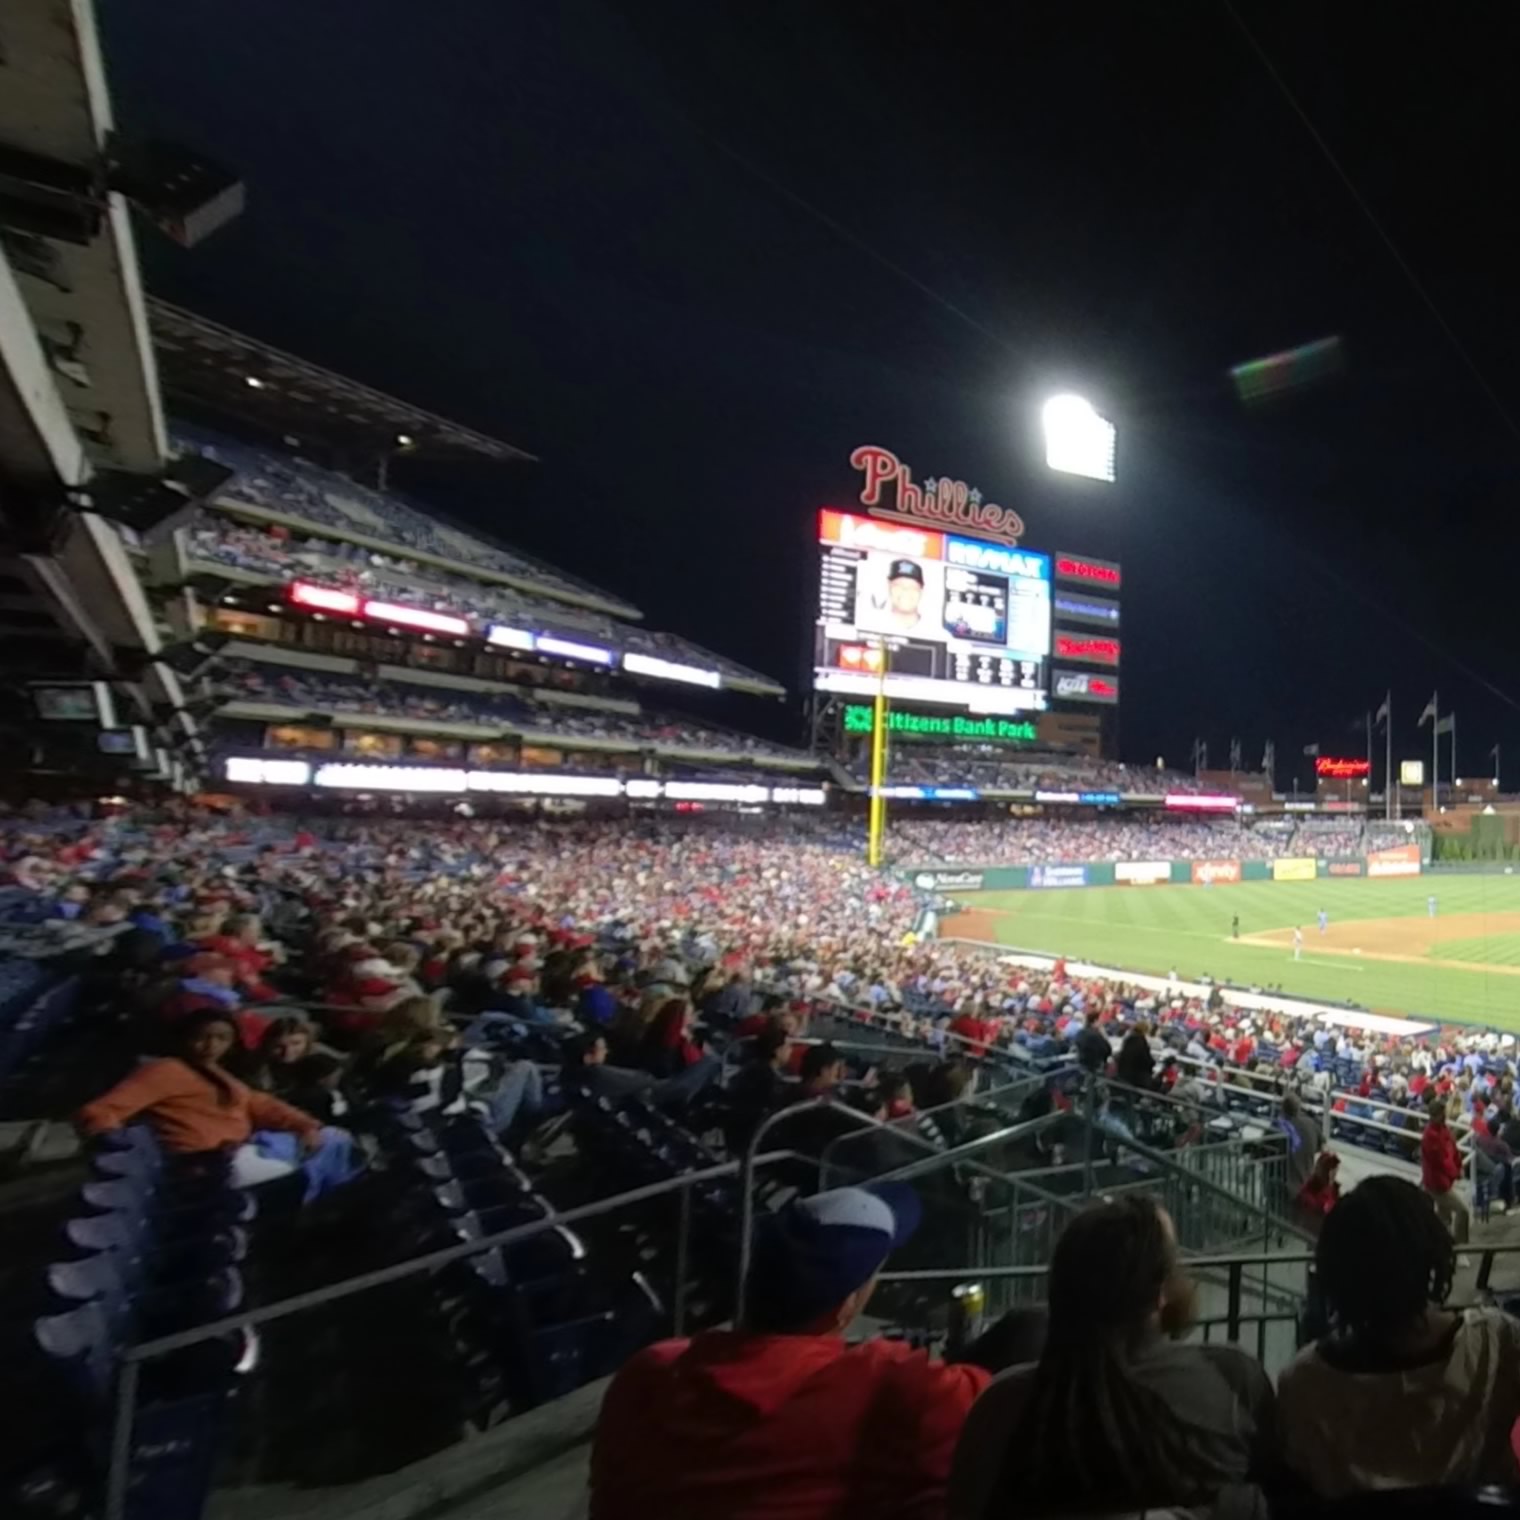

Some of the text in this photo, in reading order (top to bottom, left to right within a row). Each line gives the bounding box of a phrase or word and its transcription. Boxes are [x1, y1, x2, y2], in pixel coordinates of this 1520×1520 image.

[850, 446, 1024, 536] Phillies
[884, 711, 1037, 740] itizens Bank Park
[936, 872, 984, 884] NovaCare
